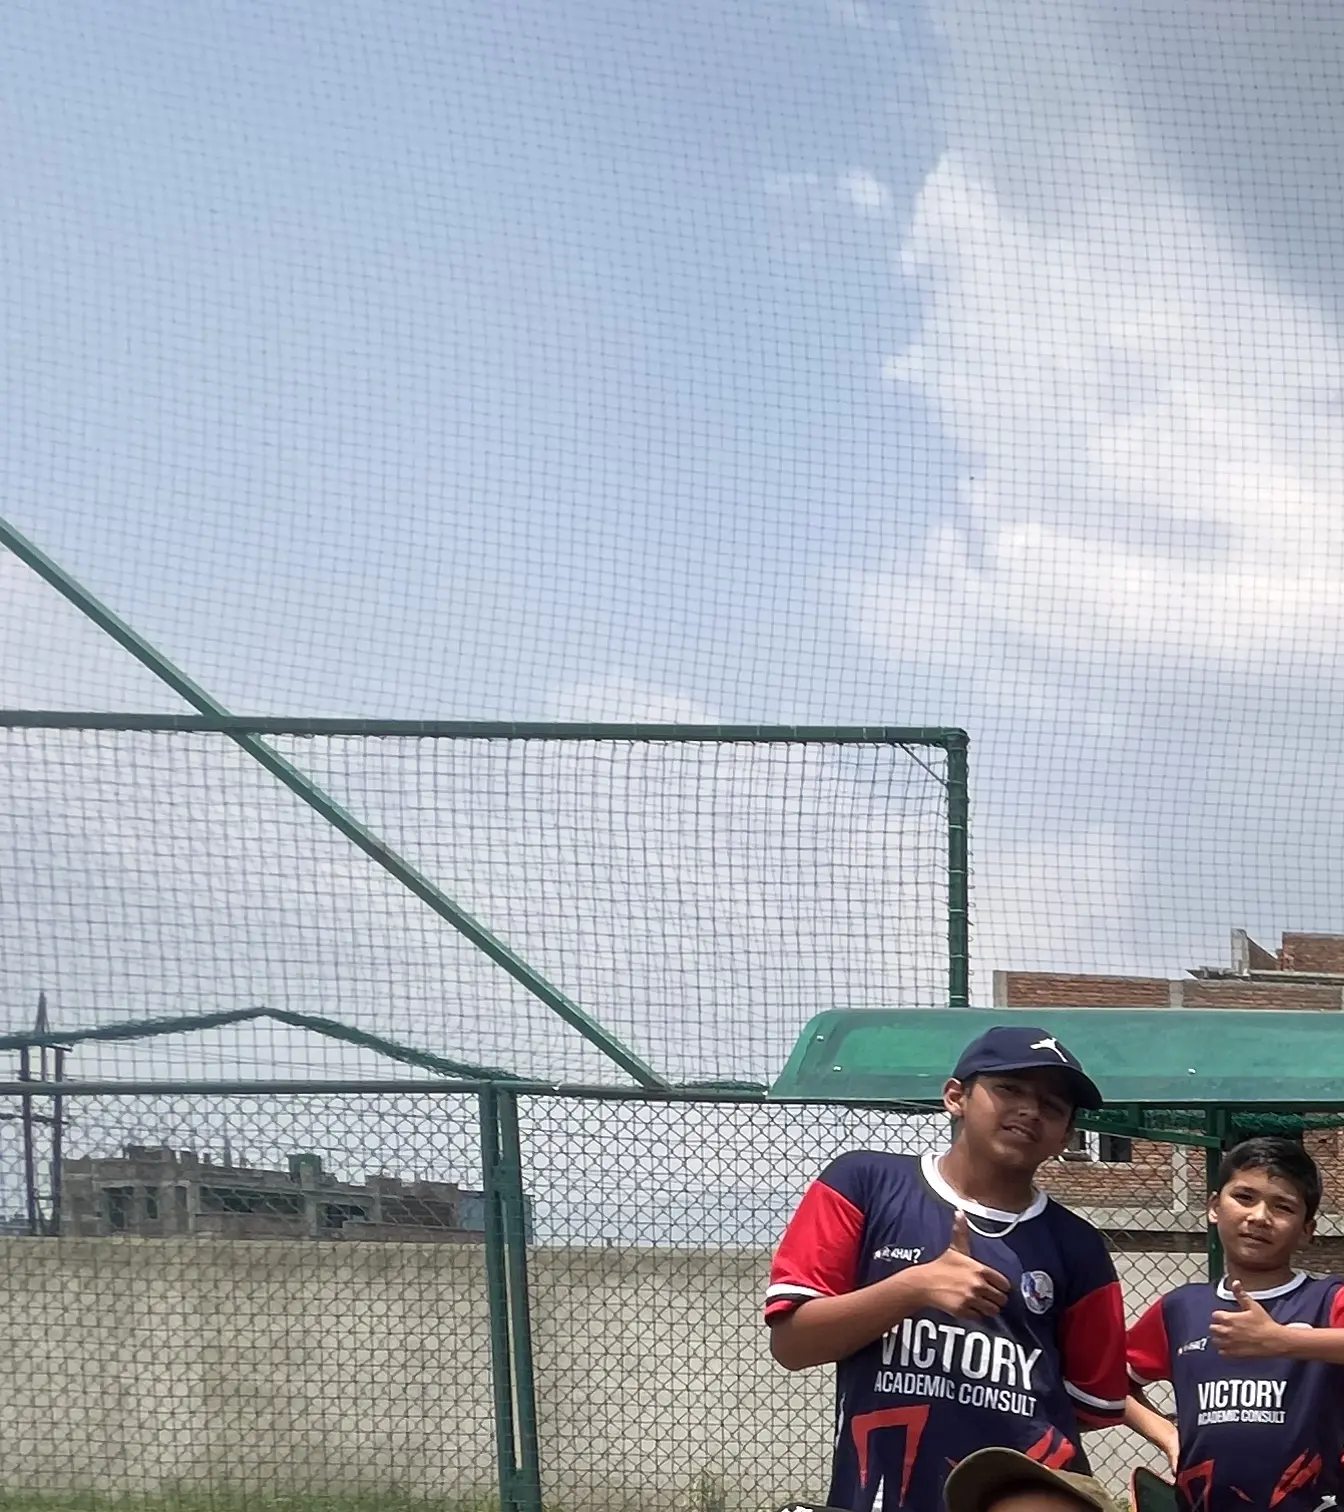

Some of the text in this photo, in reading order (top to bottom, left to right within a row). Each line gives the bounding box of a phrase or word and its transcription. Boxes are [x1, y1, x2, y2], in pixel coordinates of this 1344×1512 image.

[882, 1317, 1043, 1391] VICTORY
[873, 1370, 1038, 1418] ACADEMIC CONSULT
[1197, 1379, 1287, 1411] VICTORY
[1197, 1410, 1287, 1426] ACADEMIC CONSULT
